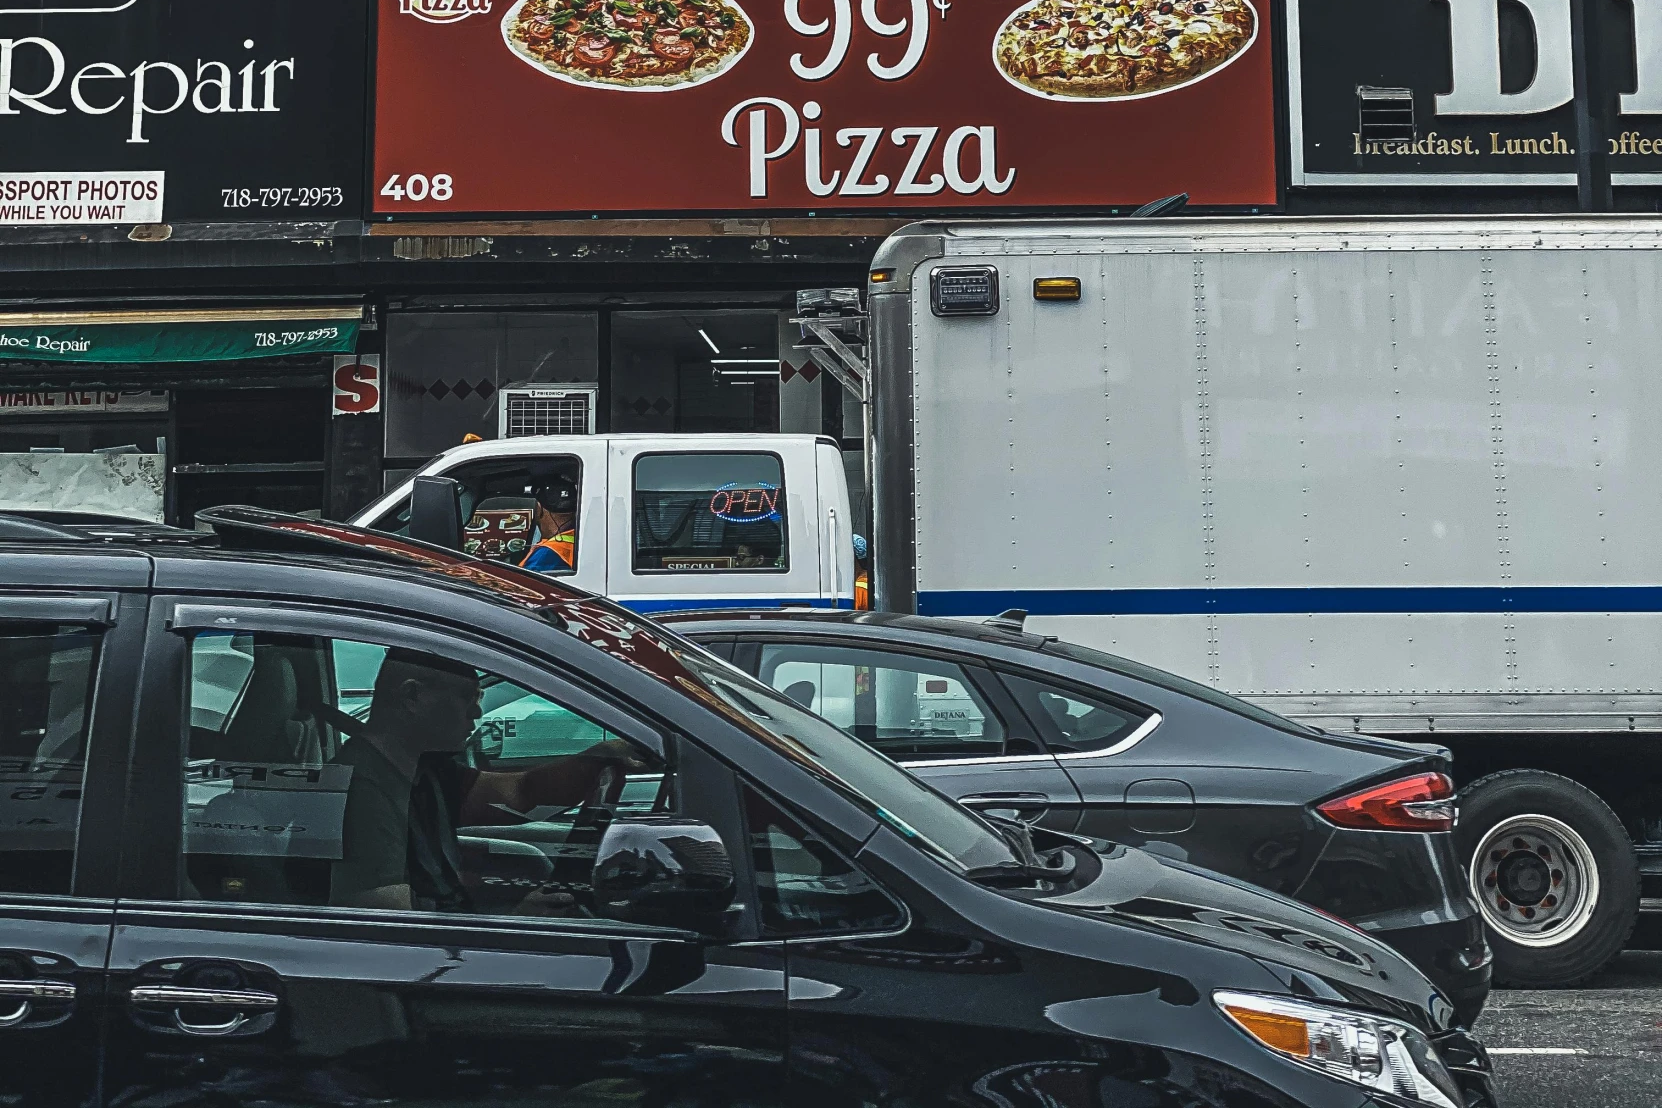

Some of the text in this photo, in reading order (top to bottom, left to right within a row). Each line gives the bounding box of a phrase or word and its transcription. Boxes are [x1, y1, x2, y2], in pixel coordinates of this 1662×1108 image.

[0, 37, 295, 143] Repair
[721, 96, 1017, 198] Pizza
[1489, 132, 1576, 155] Lunch.
[78, 180, 158, 201] PHOTOS
[221, 187, 344, 208] 718-797-2953
[380, 173, 454, 202] 408
[0, 205, 125, 220] WHILE YOU WAIT
[35, 335, 91, 354] Repair
[254, 327, 338, 347] 718-797-2953
[334, 363, 379, 413] S
[709, 489, 779, 513] OPEN
[934, 711, 967, 720] DEJANA
